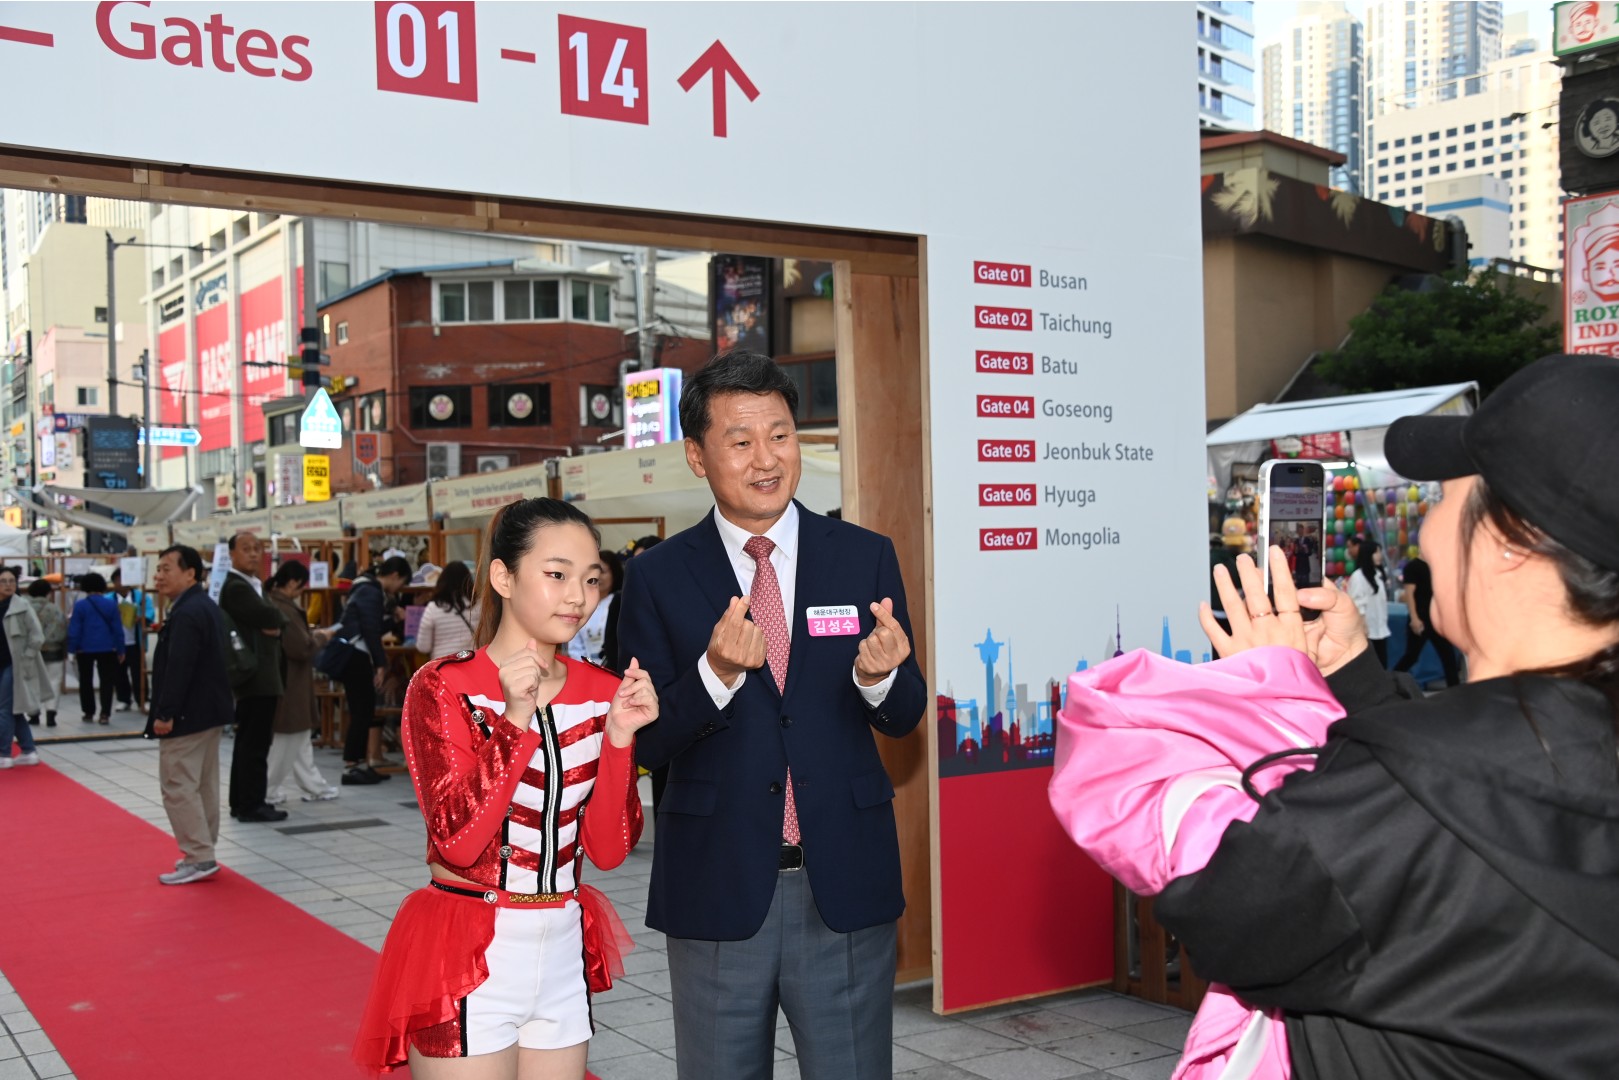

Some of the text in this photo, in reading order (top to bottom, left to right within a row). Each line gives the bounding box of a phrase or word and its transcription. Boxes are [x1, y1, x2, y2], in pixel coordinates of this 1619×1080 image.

[95, 1, 313, 82] Gates
[386, 2, 460, 84] 01
[568, 31, 639, 108] 14
[978, 265, 1088, 290] Gate 01 Busan
[978, 310, 1113, 339] Gate 02 Taichung
[1578, 322, 1618, 339] IND
[979, 354, 1078, 375] Gate 03 Batu
[980, 398, 1113, 423] Gate 04 Goseong
[981, 442, 1154, 461] Gate 05 Jeonbuk State
[982, 485, 1096, 507] Gate 06 Hyuga
[983, 527, 1121, 550] Gate 07 Mongolia
[813, 608, 851, 616] 해운대구청장
[813, 619, 855, 634] 김성수
